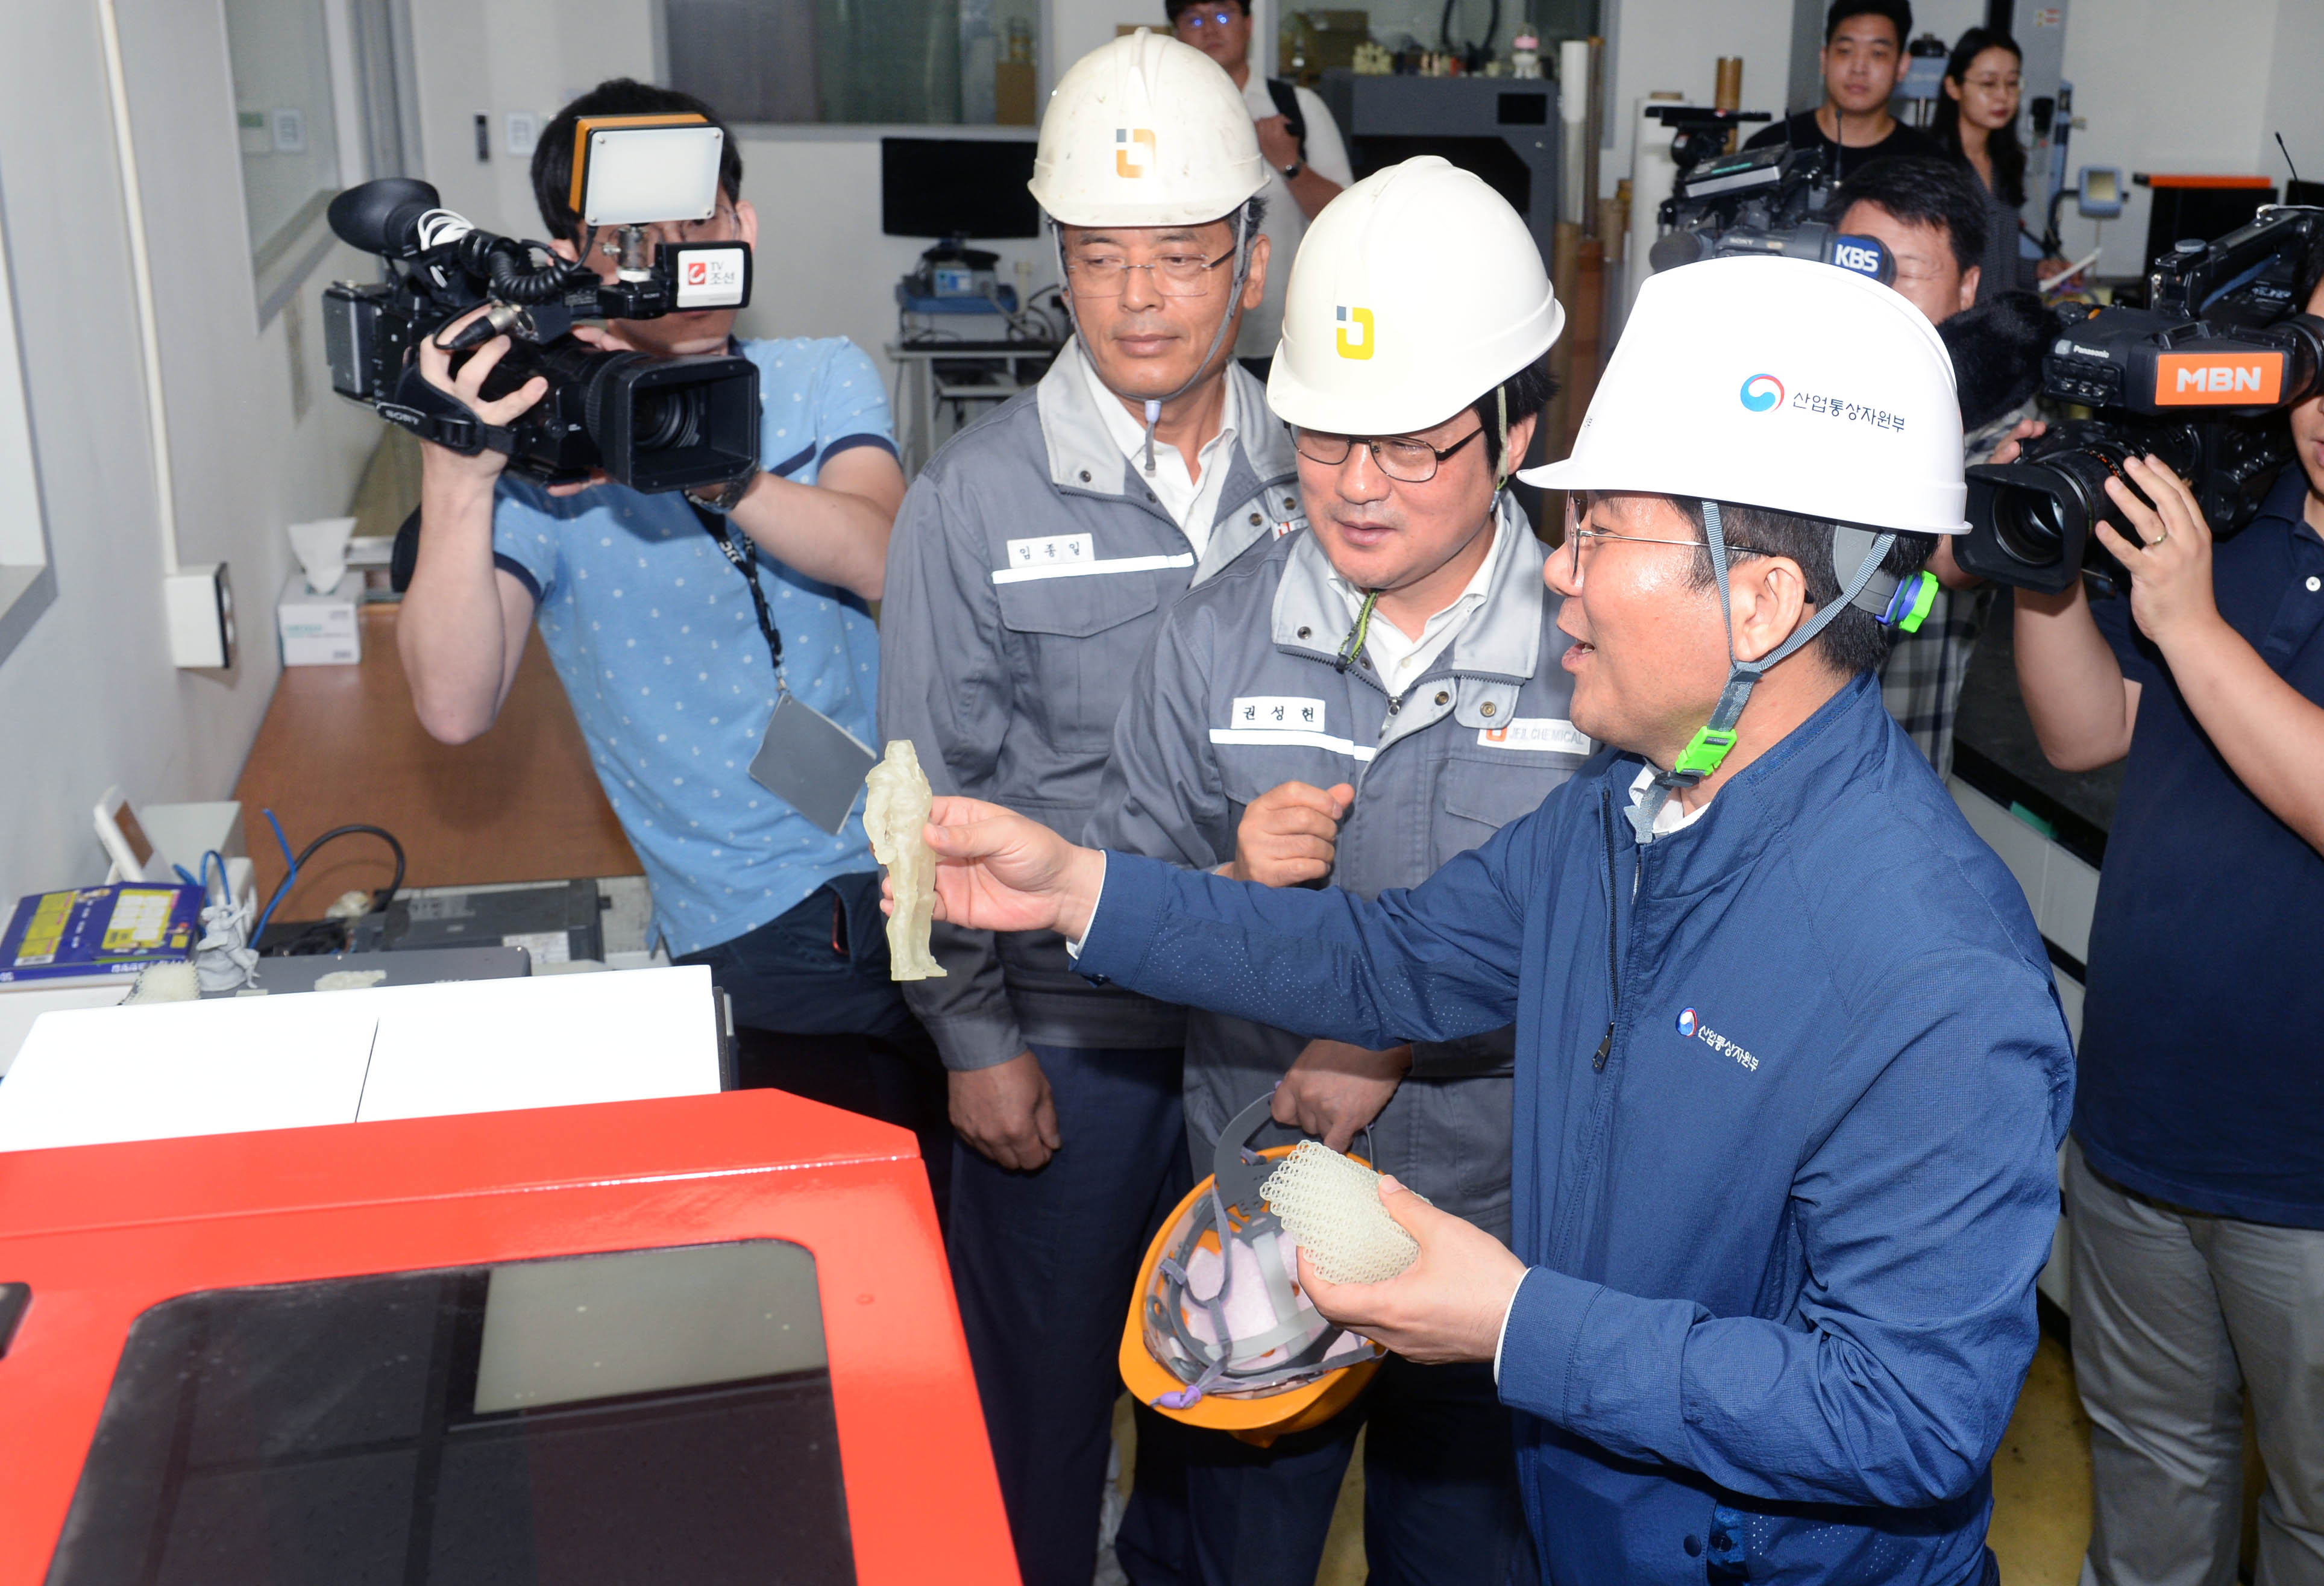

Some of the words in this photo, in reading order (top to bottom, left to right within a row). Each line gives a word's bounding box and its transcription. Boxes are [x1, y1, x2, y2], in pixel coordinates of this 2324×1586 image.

[711, 262, 724, 271] TV
[1835, 244, 1879, 272] KBS
[709, 272, 735, 285] 조선
[2073, 345, 2109, 359] Panasonic
[2176, 367, 2261, 392] MBN
[1793, 392, 1905, 433] 산업통상자원부
[1531, 727, 1584, 745] CHEMICAL
[1698, 1025, 1759, 1072] 산업통상자원부
